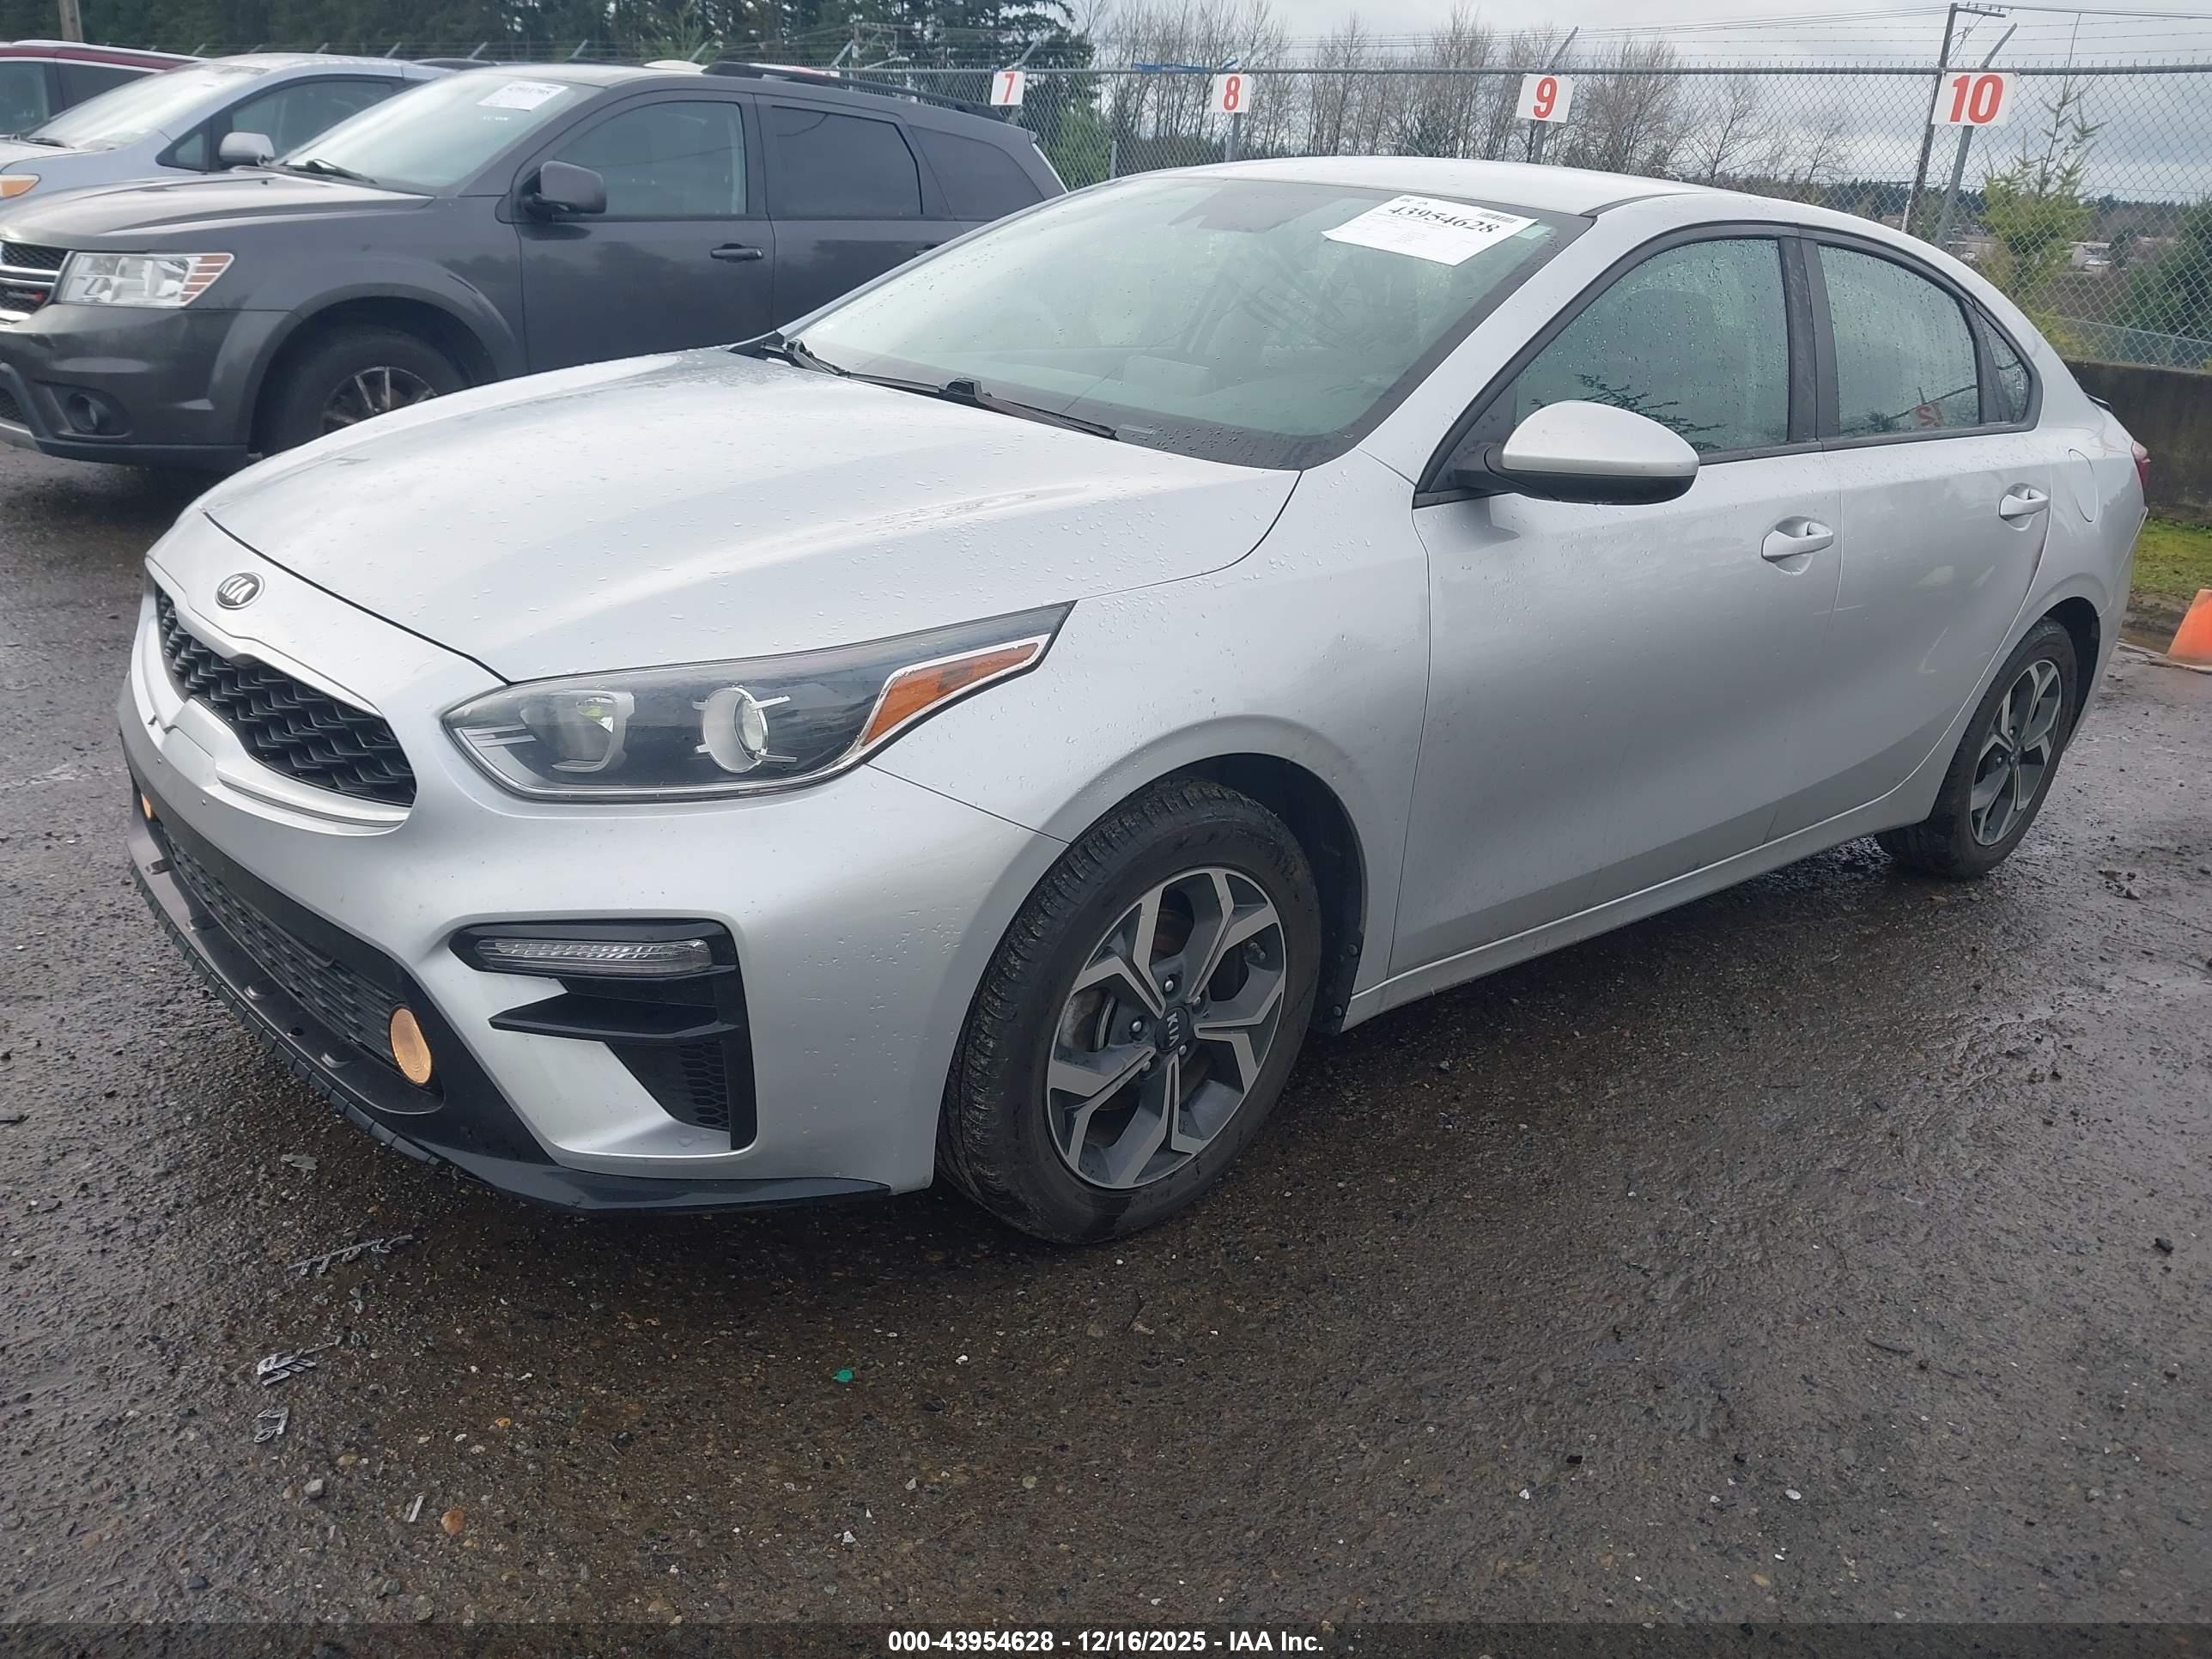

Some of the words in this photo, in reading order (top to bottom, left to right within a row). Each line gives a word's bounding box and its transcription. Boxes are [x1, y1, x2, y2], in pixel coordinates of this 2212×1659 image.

[1003, 72, 1016, 104] 7
[1223, 76, 1242, 112] 8
[1533, 76, 1558, 118] 9
[1949, 74, 2004, 124] 10
[1388, 205, 1501, 234] 43954628
[218, 574, 256, 605] KIA
[1166, 1011, 1181, 1048] KIA
